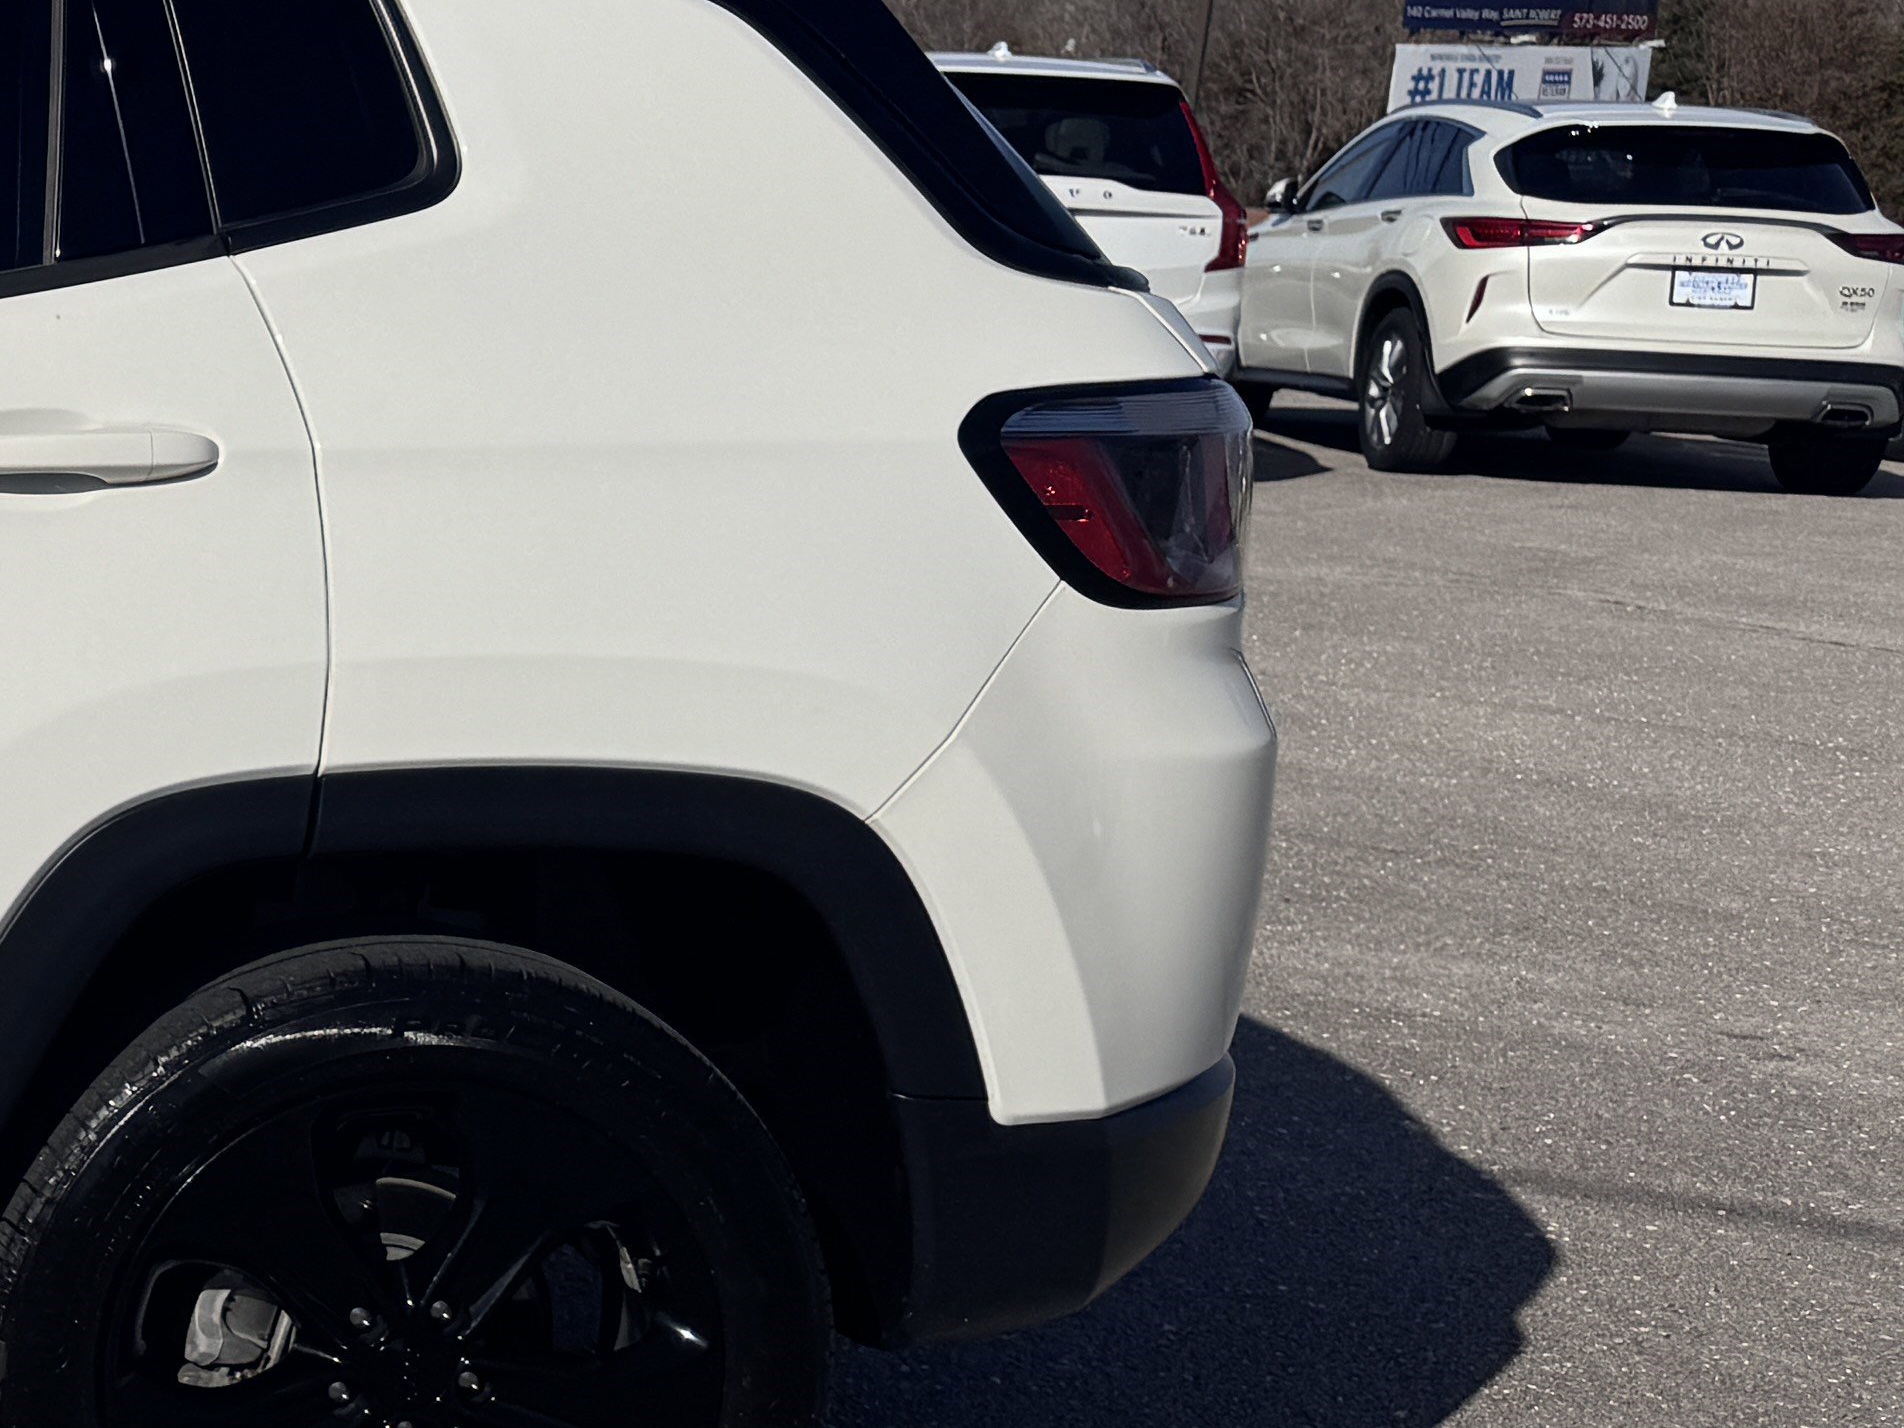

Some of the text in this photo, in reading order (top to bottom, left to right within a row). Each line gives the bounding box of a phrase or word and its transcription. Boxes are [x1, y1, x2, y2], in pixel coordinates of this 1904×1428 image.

[1572, 12, 1649, 30] 573-451-2500
[1672, 255, 1771, 267] INFINITI
[1839, 285, 1875, 299] QX50
